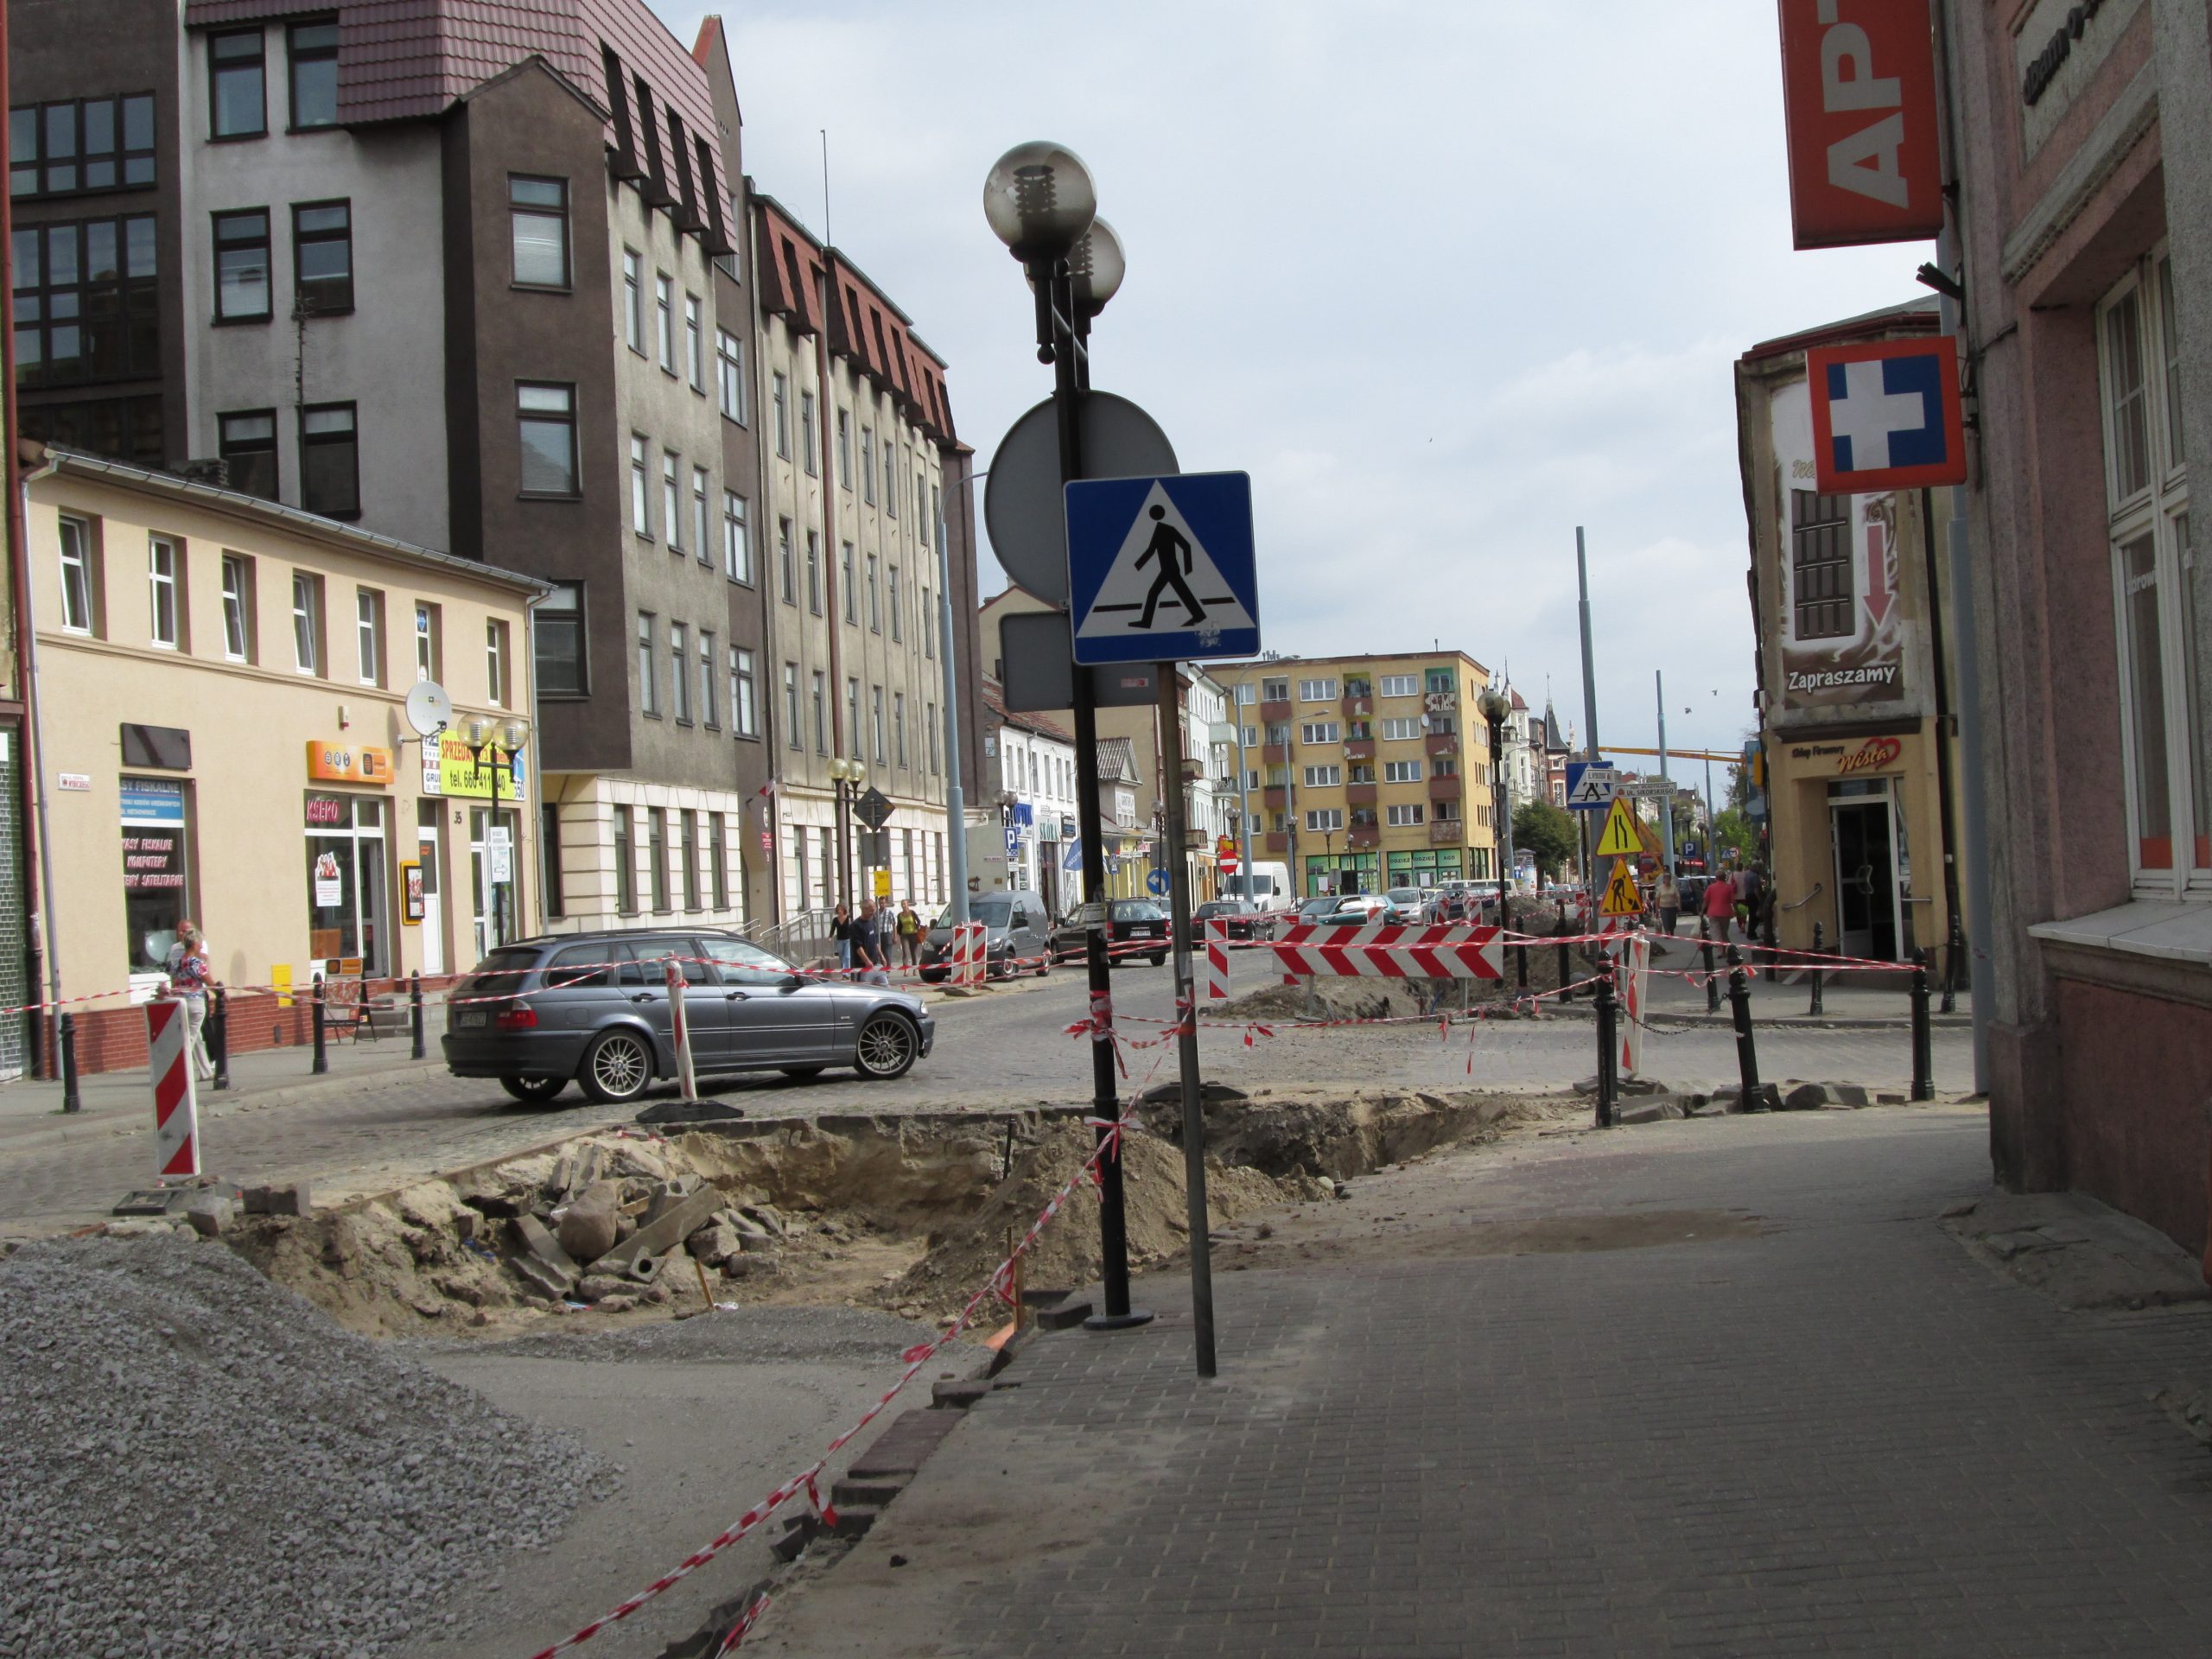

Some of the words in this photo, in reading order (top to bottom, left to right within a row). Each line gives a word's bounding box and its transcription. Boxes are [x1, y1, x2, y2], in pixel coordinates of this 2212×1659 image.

[1817, 0, 1909, 209] AP
[1788, 666, 1896, 693] Zapraszamy
[449, 770, 462, 787] tel.
[306, 799, 338, 822] KSERO
[1039, 817, 1058, 841] SKÓRA
[141, 838, 173, 851] FISKALNE
[127, 855, 168, 868] KOMPUTERY
[141, 874, 184, 887] SATELITARNE
